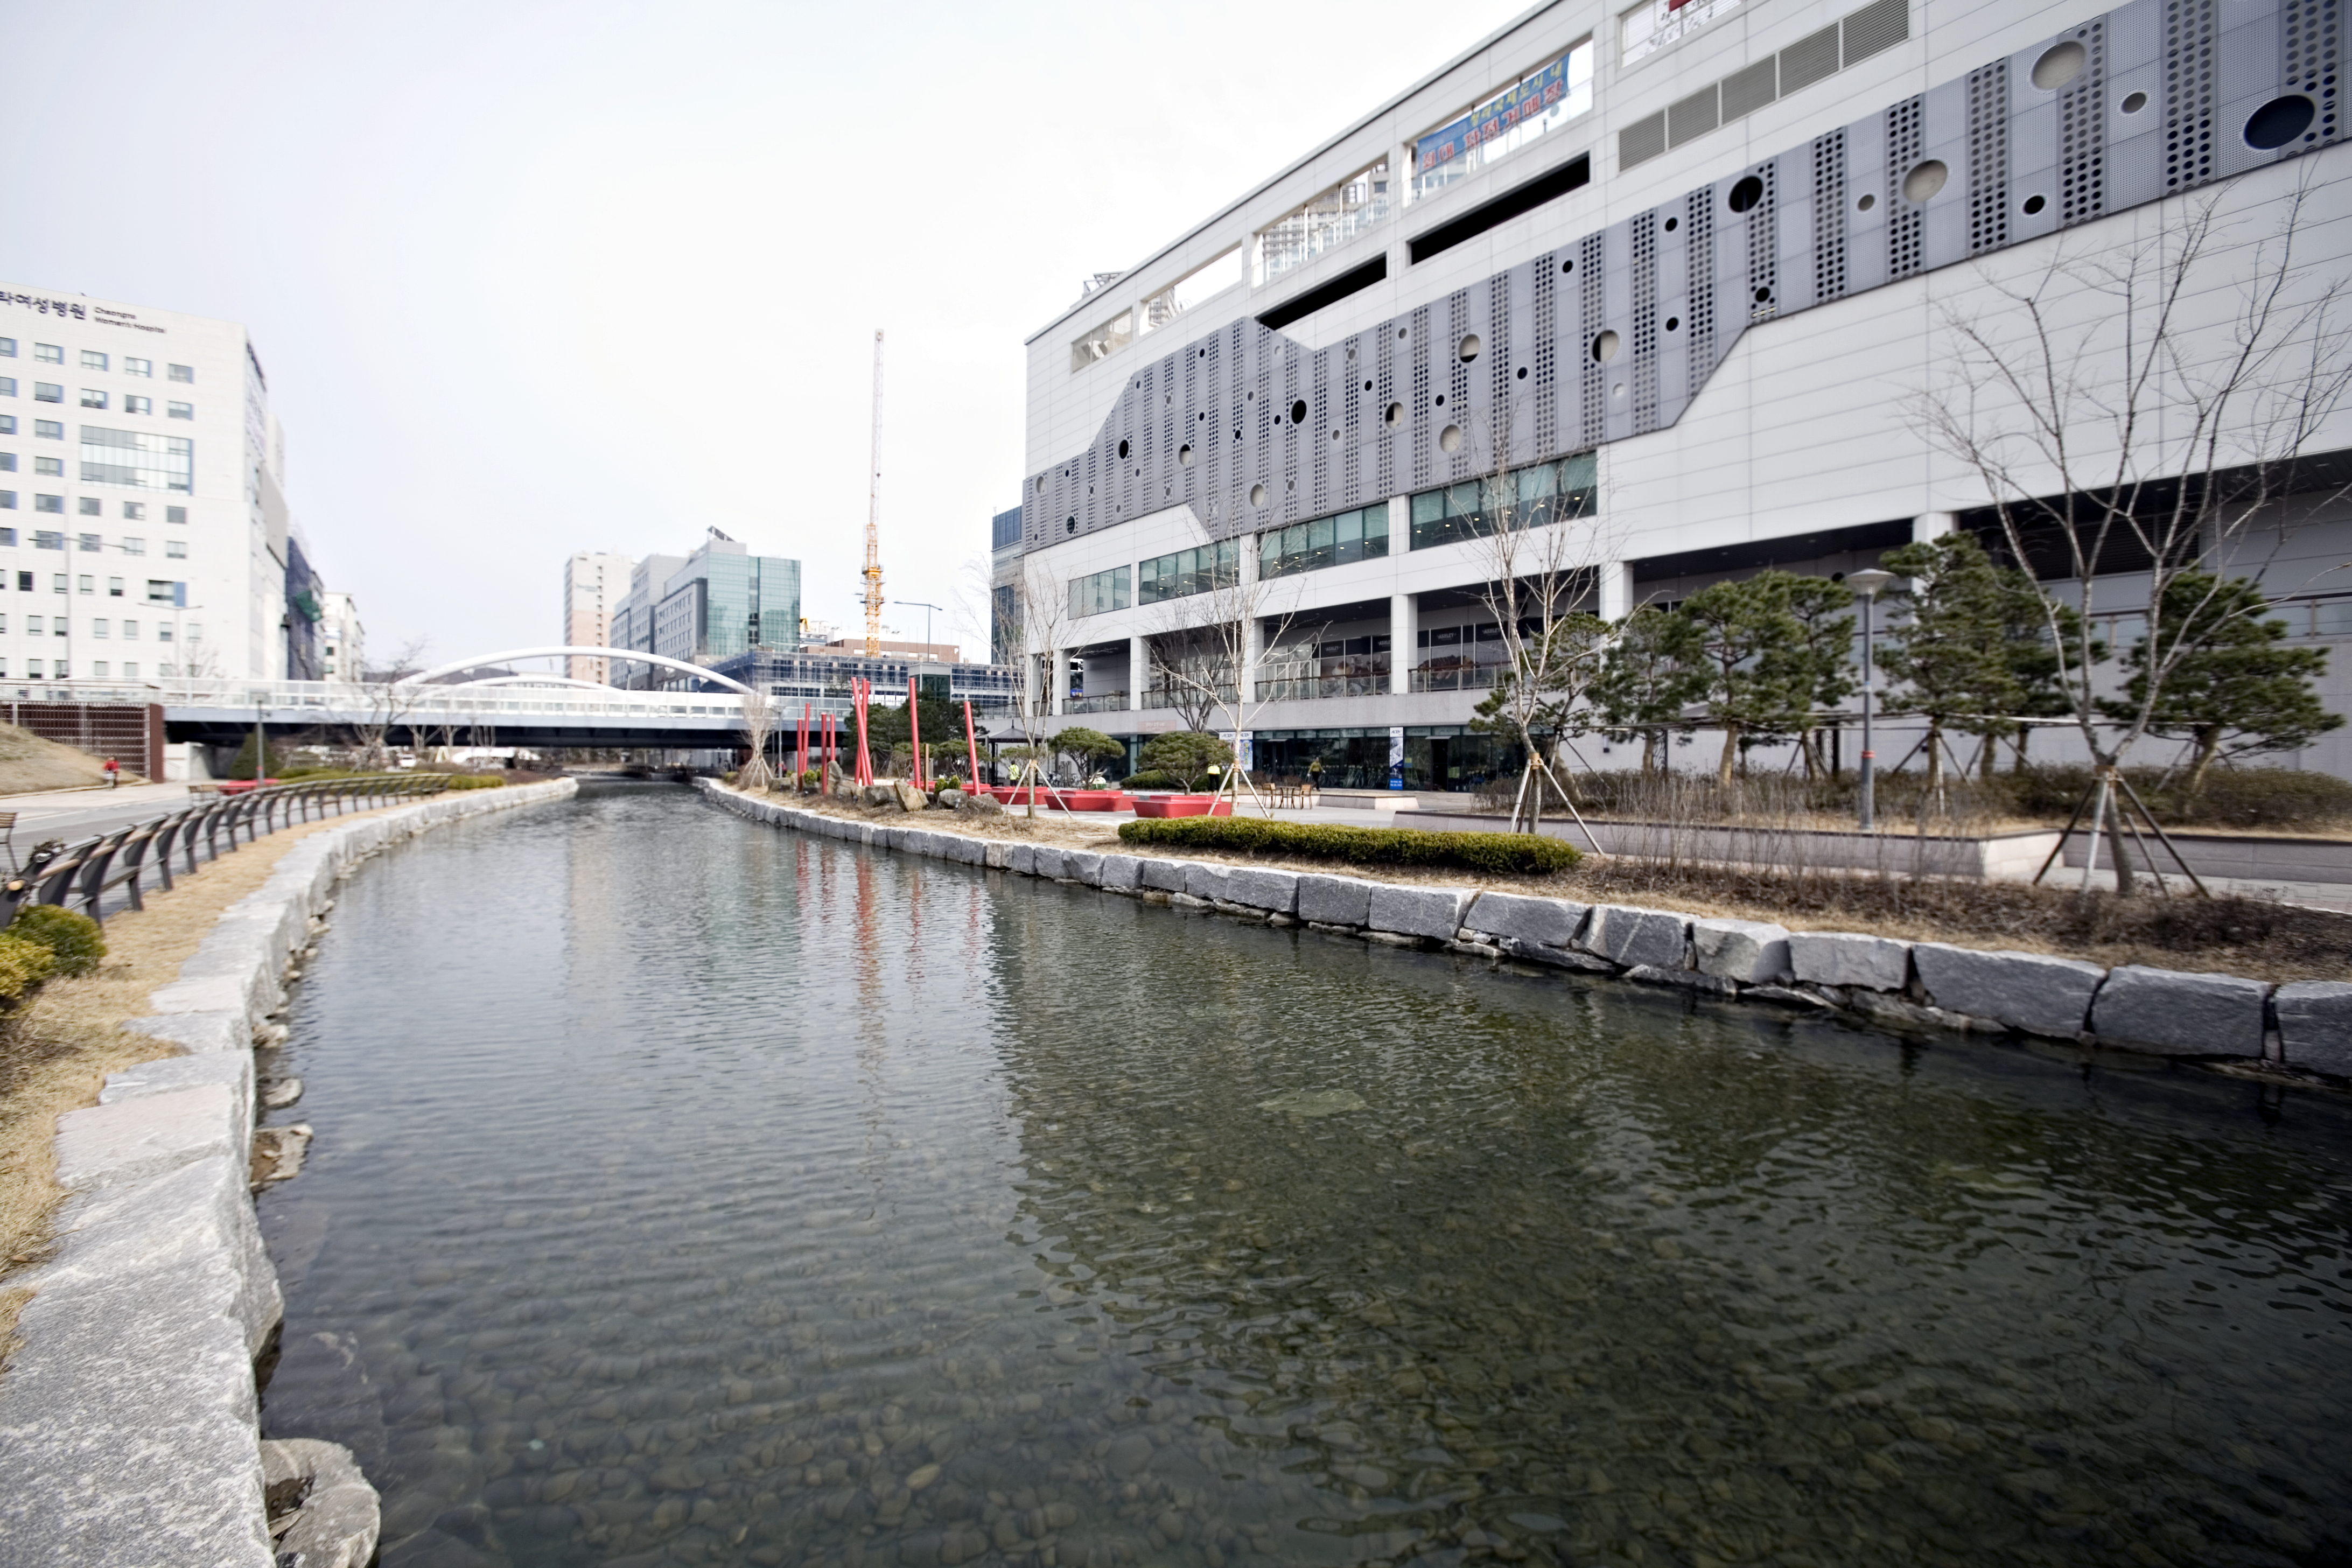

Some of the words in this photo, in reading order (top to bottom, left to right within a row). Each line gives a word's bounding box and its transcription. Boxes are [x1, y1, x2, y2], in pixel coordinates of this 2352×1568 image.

[1550, 61, 1562, 78] 내
[0, 291, 86, 320] 라여성병원
[133, 323, 167, 334] Hospital
